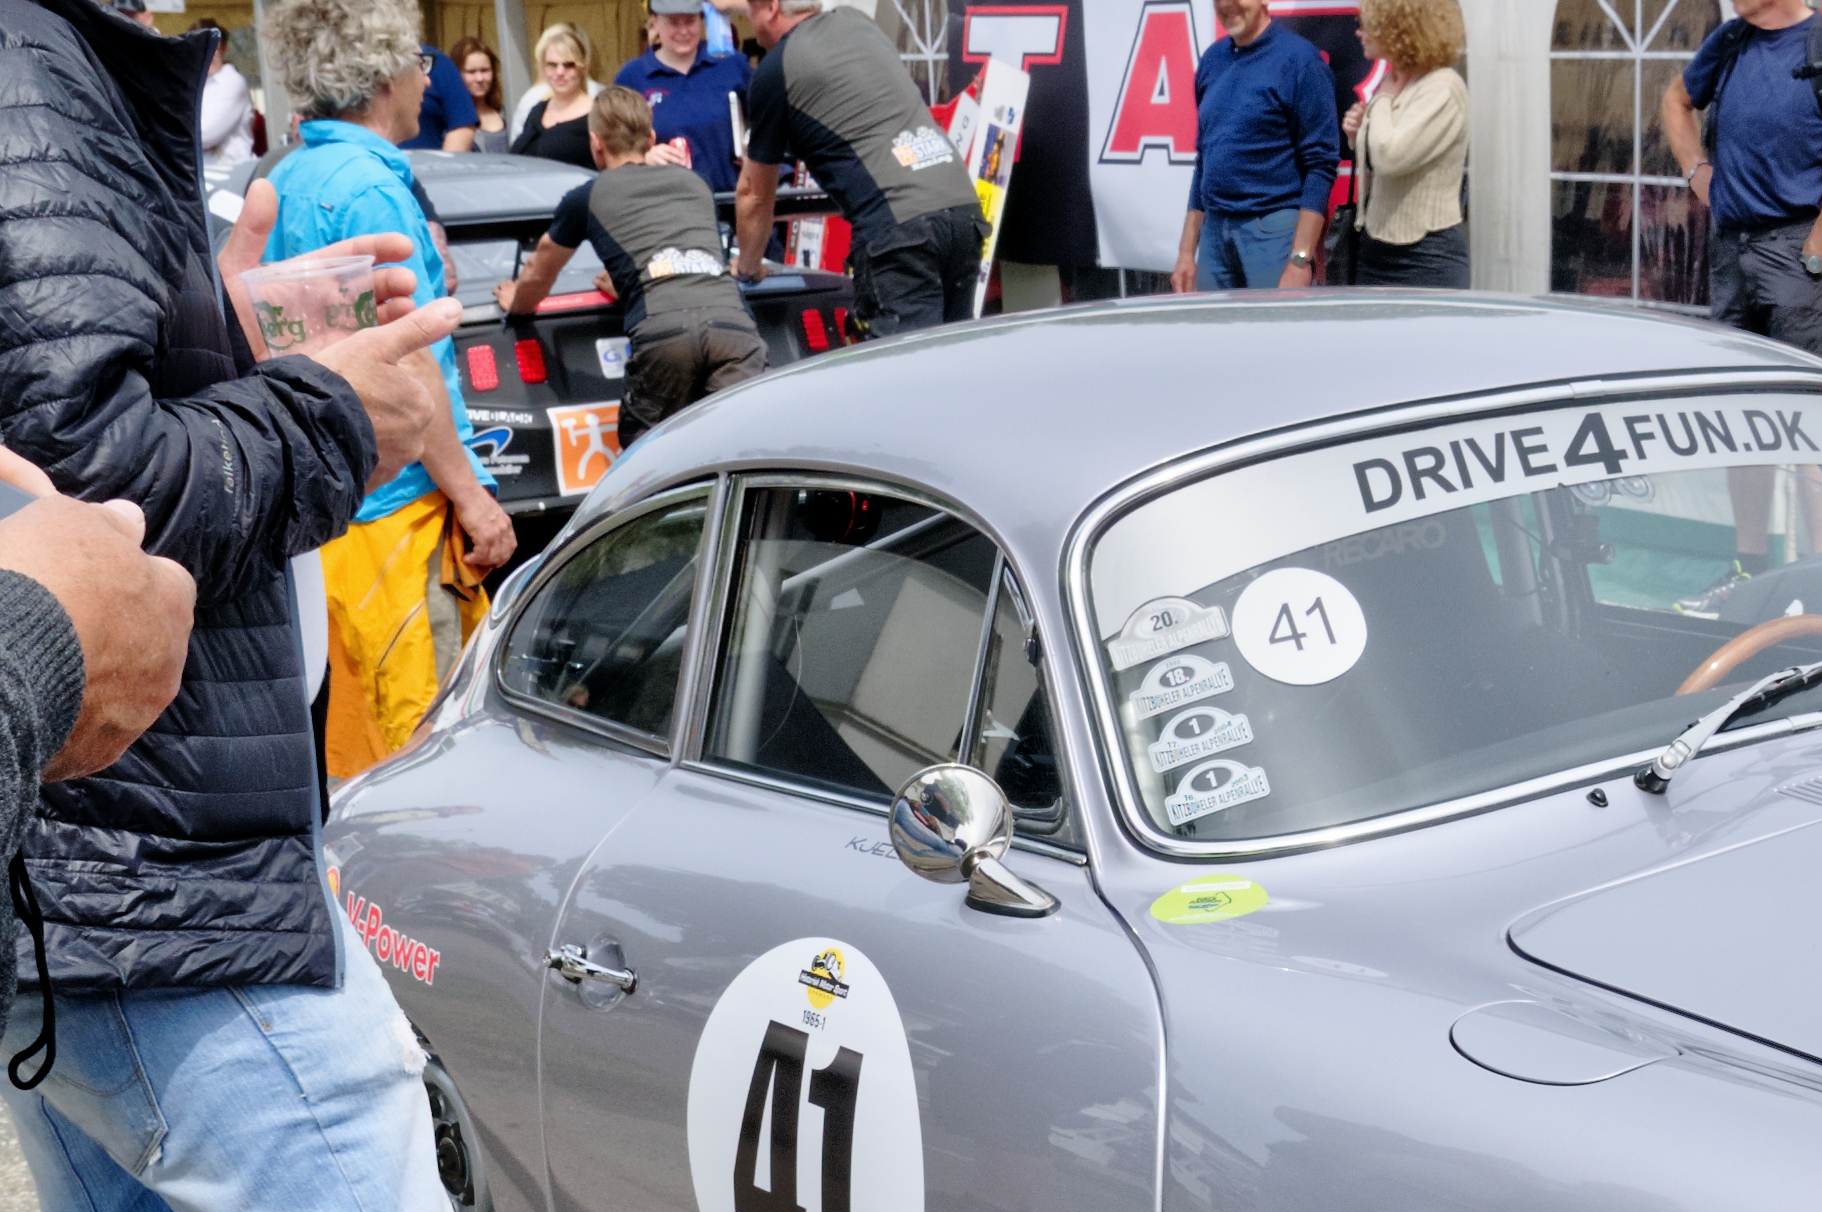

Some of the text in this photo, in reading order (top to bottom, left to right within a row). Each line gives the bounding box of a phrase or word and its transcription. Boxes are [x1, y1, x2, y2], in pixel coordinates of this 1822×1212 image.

[1352, 409, 1819, 513] DRIVE4FUN.DK
[1324, 518, 1447, 568] RECARO
[1267, 595, 1338, 653] 41
[1188, 718, 1201, 735] 1
[1202, 720, 1249, 751] ALPENRALLYE
[1205, 771, 1218, 787] 1
[1219, 776, 1265, 805] ALPENRALLYE
[347, 890, 441, 985] V-Power
[803, 1009, 827, 1031] 1965-1
